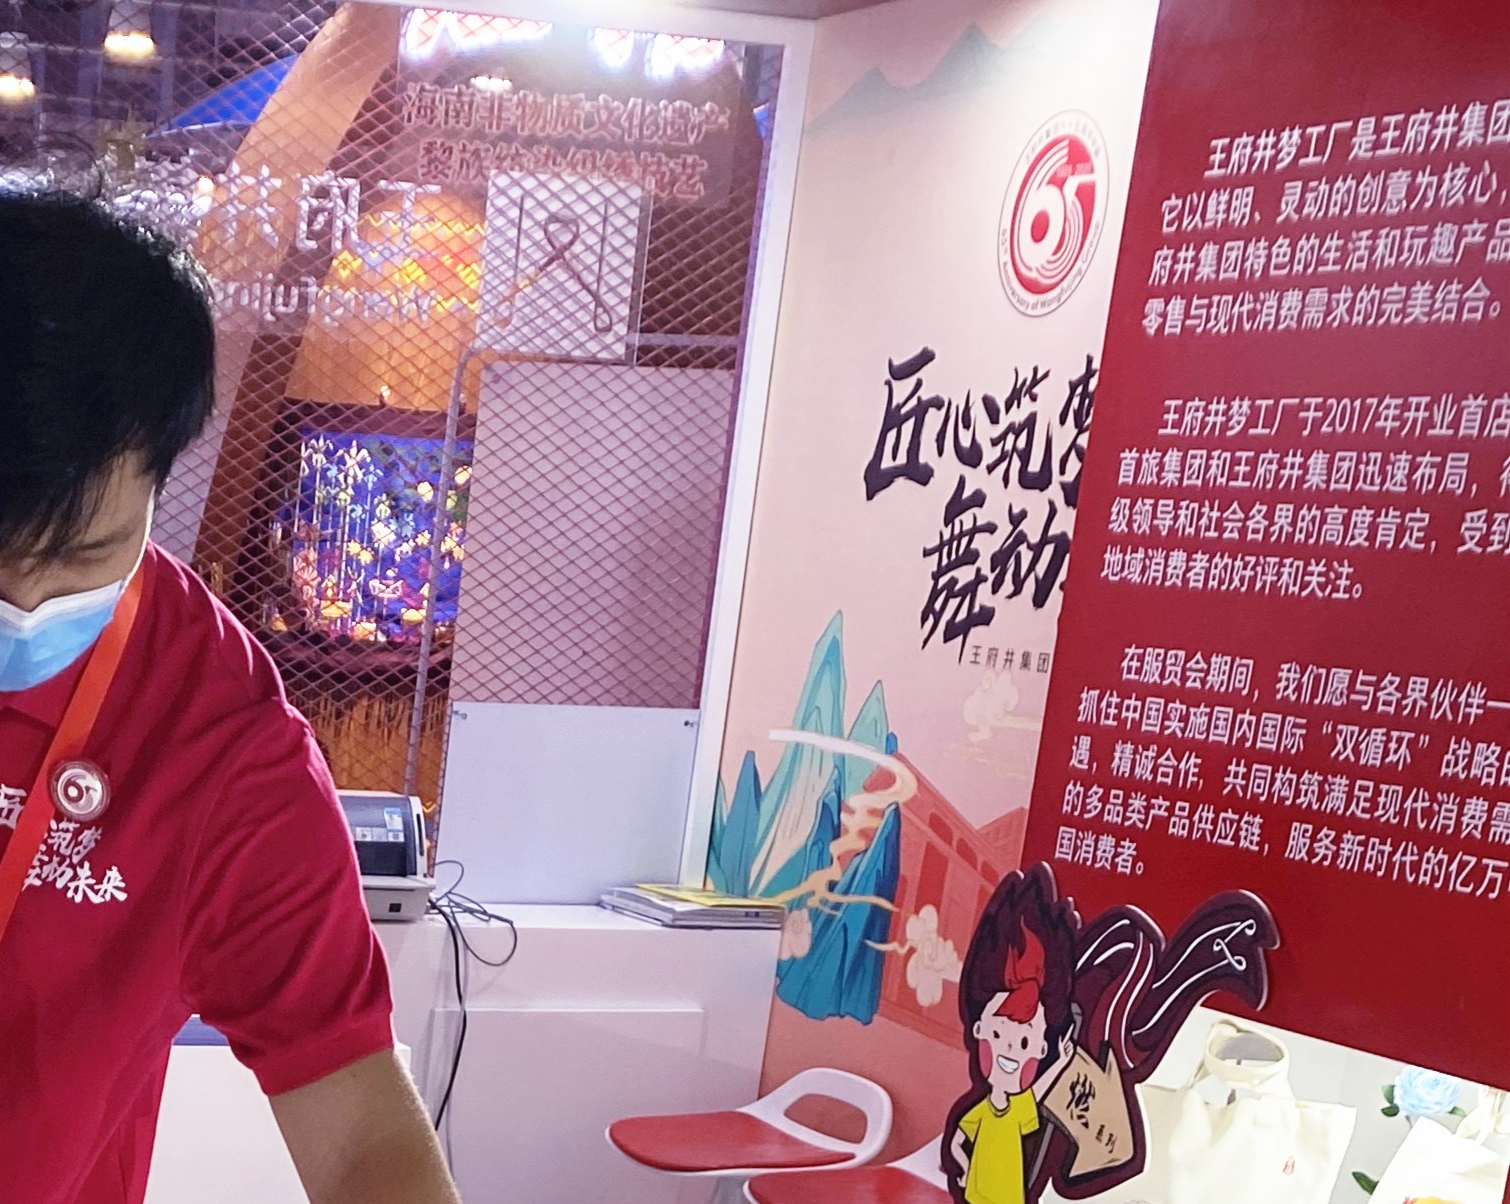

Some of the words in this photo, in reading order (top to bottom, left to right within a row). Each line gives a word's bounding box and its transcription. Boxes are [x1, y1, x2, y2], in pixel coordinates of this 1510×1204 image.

[1203, 99, 1510, 178] 王府井梦工厂是王府井集团
[1148, 217, 1510, 287] 府井集团特色的生活和玩趣产品
[1141, 275, 1502, 337] 零售与现代消费需求的完美结合。
[1157, 392, 1510, 438] 王府井梦工厂于2017年开业首店
[1099, 544, 1364, 600] 地域消费者的好评和关注。
[968, 643, 1053, 676] 王府井集团
[1053, 825, 1145, 877] 国消费者。
[1061, 780, 1510, 900] 的多品类产品供应链，服务新时代的亿万
